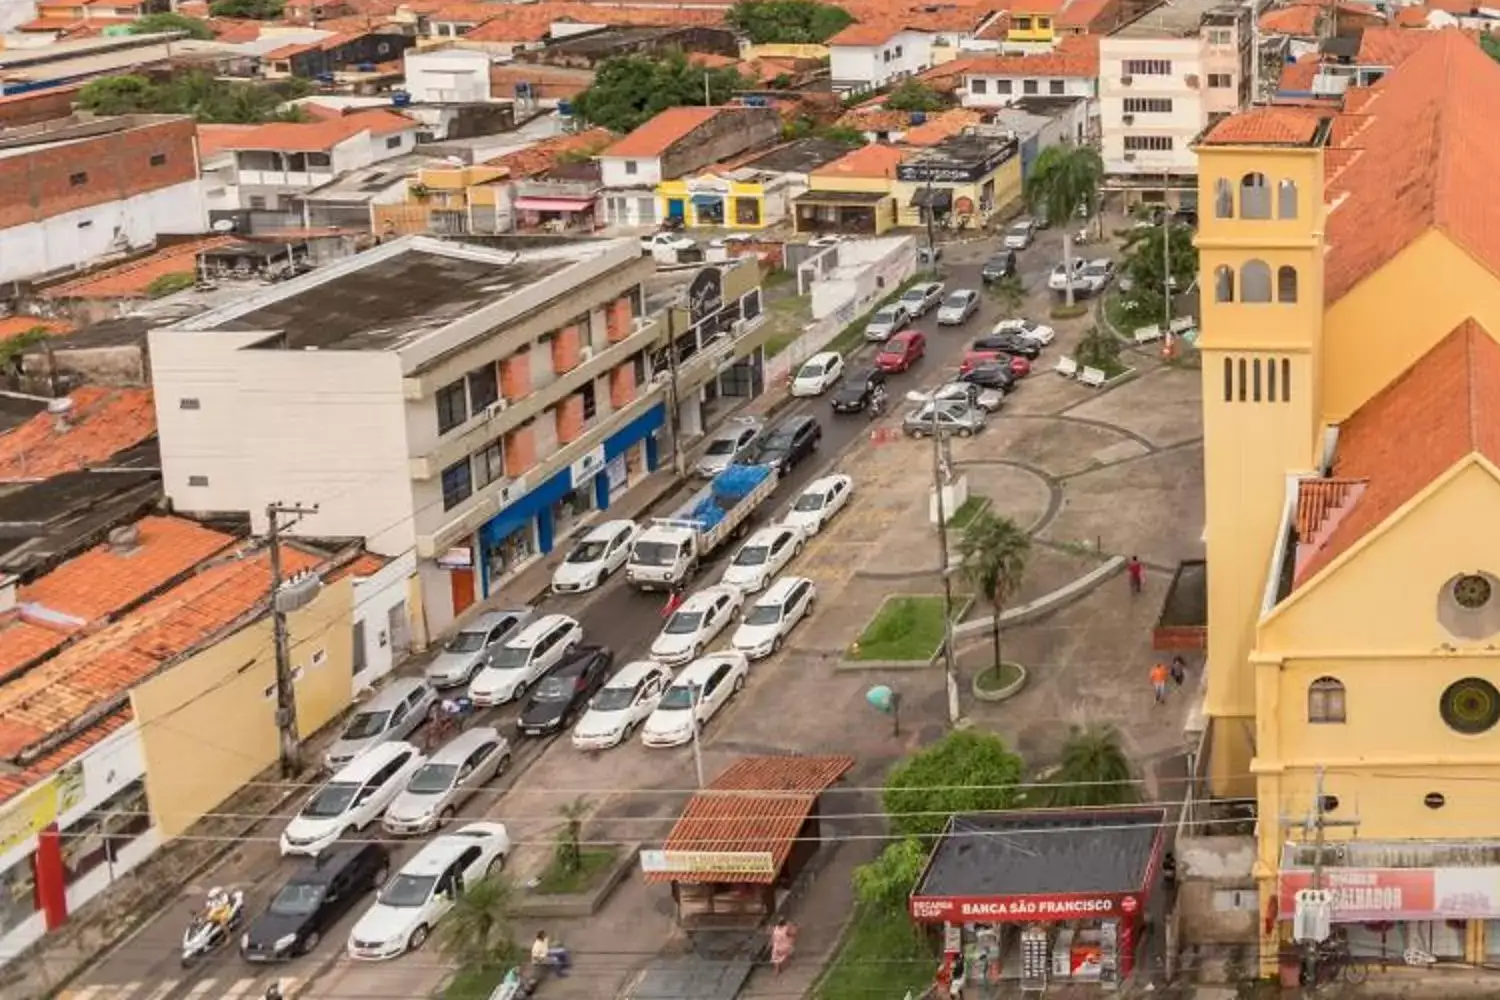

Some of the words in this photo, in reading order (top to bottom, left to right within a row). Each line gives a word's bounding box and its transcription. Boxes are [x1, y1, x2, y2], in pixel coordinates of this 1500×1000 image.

[961, 902, 1006, 915] BANCA
[1010, 900, 1036, 913] SÃO
[1038, 899, 1112, 912] FRANCISCO
